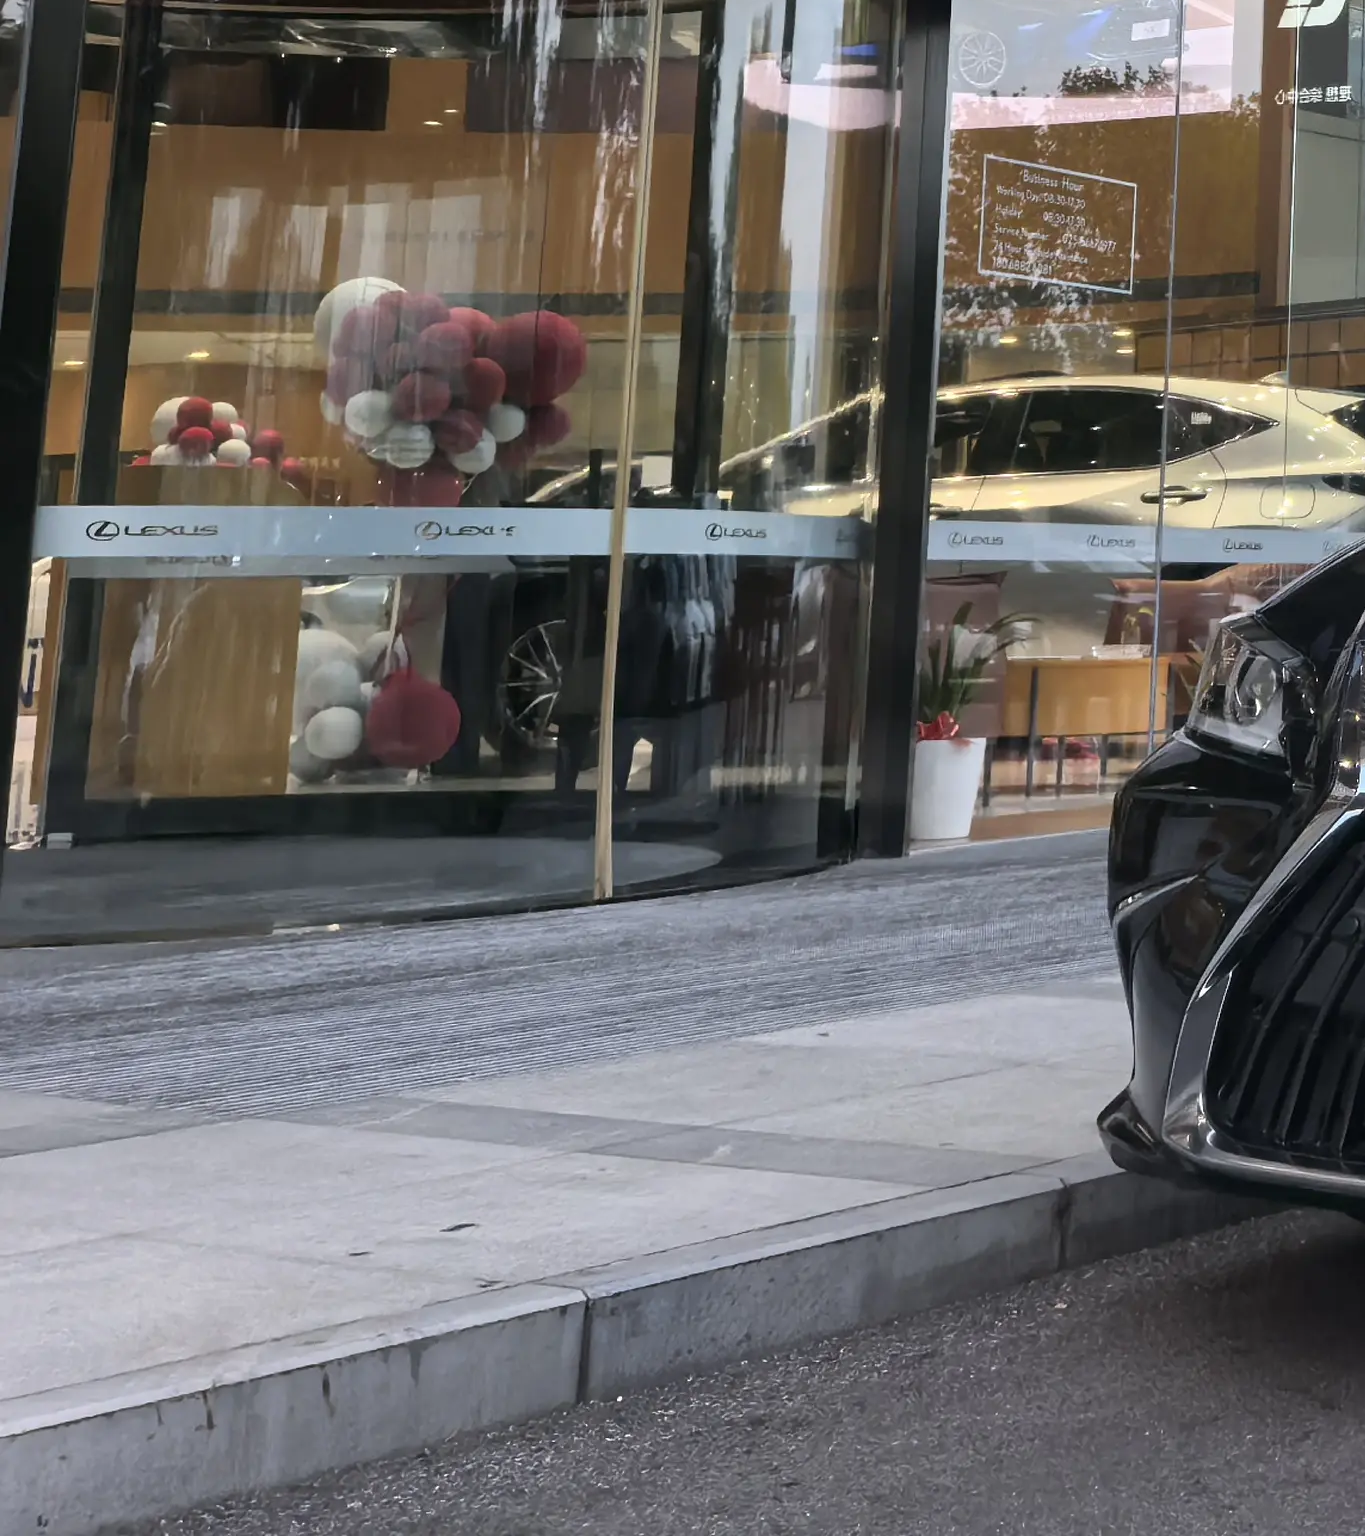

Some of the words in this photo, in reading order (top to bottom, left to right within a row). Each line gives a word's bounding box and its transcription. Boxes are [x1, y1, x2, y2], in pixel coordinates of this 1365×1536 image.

[1023, 169, 1058, 188] Business
[1061, 176, 1084, 192] Hour
[124, 525, 219, 537] LEXUS
[723, 527, 767, 539] LEXUS
[963, 536, 1004, 546] LEXUS
[1100, 538, 1136, 548] LEXUS
